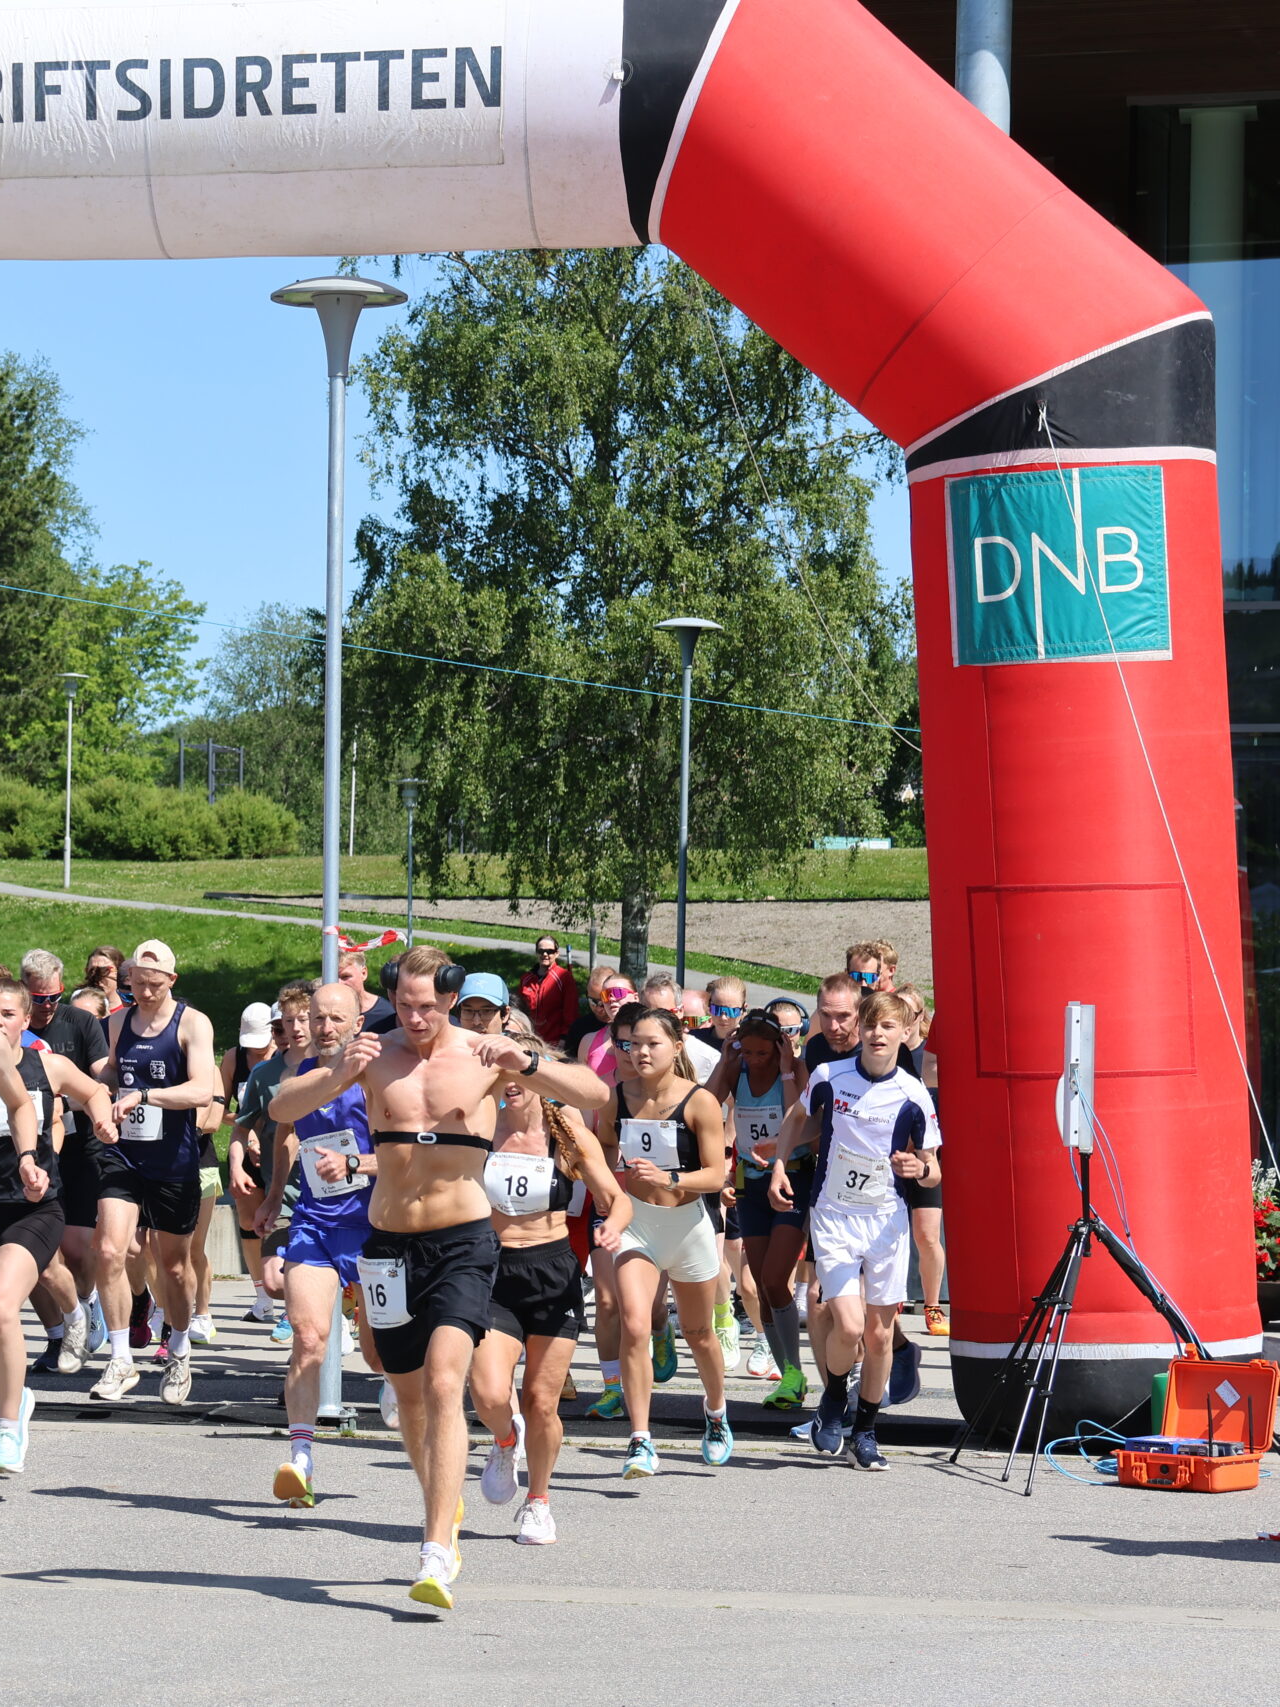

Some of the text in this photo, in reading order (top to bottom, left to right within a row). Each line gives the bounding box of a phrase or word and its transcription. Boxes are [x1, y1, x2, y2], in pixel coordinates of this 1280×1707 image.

[974, 468, 1145, 660] DNB
[129, 1106, 145, 1124] 58
[641, 1132, 652, 1152] 9
[750, 1123, 769, 1141] 54
[504, 1175, 529, 1198] 18
[845, 1170, 871, 1191] 37
[368, 1283, 387, 1307] 16
